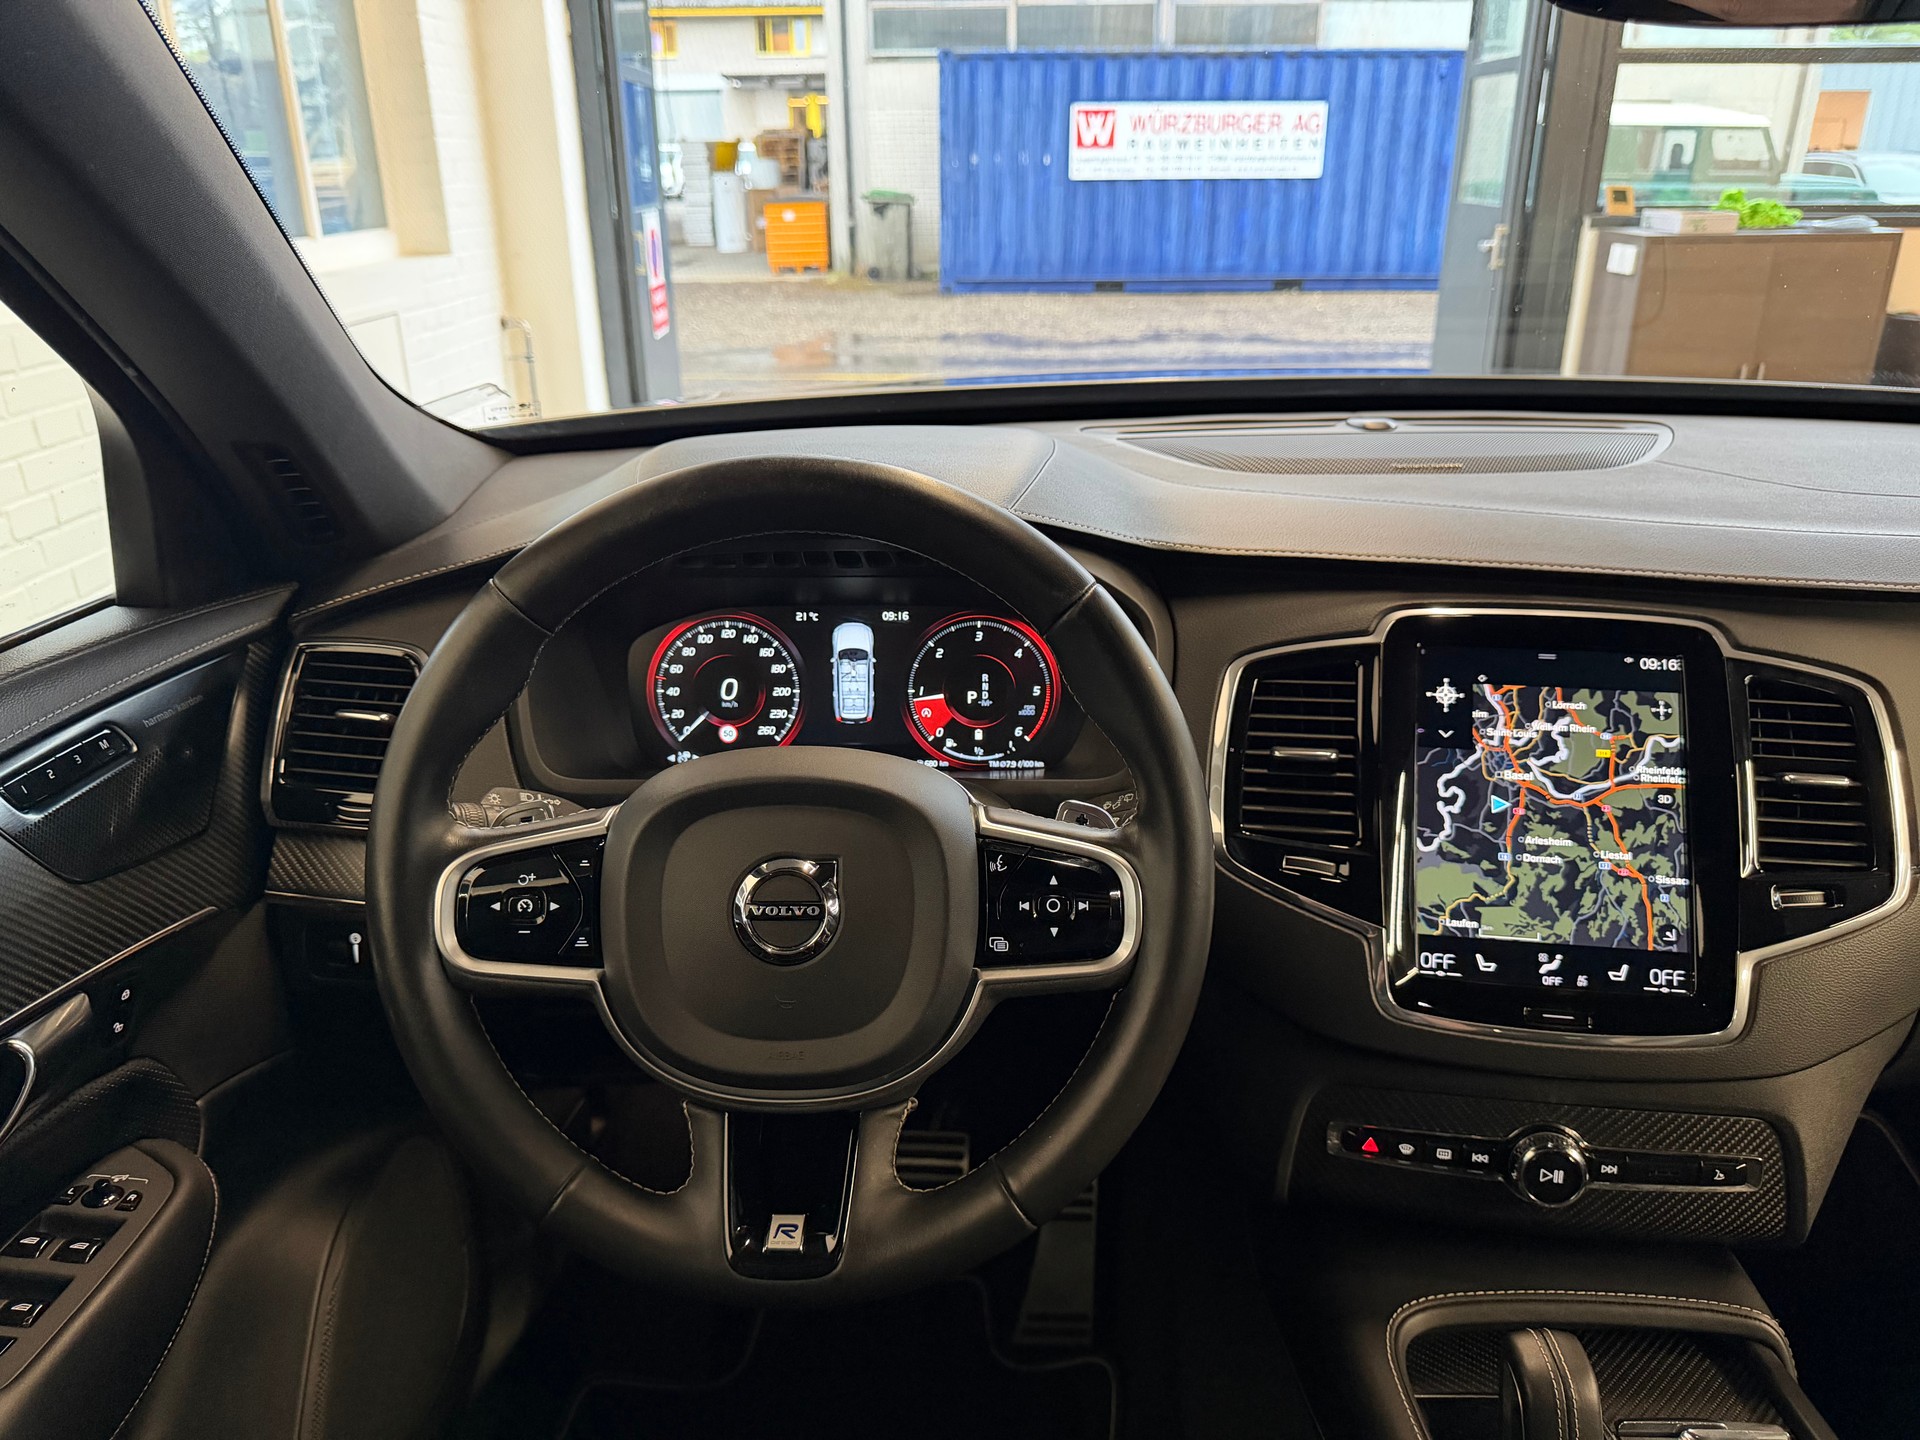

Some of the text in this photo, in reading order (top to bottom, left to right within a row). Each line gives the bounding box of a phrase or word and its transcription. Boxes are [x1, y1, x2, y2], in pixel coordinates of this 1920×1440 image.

[1129, 106, 1321, 134] WÜRZBURGER AG
[1077, 109, 1116, 149] W
[795, 611, 807, 621] 21
[882, 611, 910, 621] 09:16
[697, 634, 714, 644] 100
[720, 629, 737, 639] 120
[742, 634, 759, 644] 140
[974, 631, 984, 642] 3
[681, 647, 696, 657] 80
[758, 647, 775, 657] 160
[935, 648, 944, 658] 2
[1014, 648, 1023, 658] 4
[669, 664, 684, 674] 60
[770, 664, 787, 674] 180
[1639, 657, 1677, 671] 09:16
[982, 673, 989, 682] R
[720, 678, 739, 701] 0
[772, 686, 792, 697] 200
[982, 682, 989, 691] N
[1032, 686, 1042, 696] 5
[666, 687, 681, 697] 40
[967, 690, 978, 704] P
[982, 691, 989, 700] D
[721, 700, 739, 709] km/h
[1552, 700, 1588, 710] Lörrach
[670, 709, 685, 719] 20
[769, 709, 788, 719] 230
[723, 729, 734, 738] 50
[757, 725, 776, 736] 260
[936, 728, 944, 738] 0
[1014, 726, 1024, 737] 6
[1570, 724, 1597, 733] Rhein
[100, 738, 110, 750] M
[73, 754, 82, 764] 3
[46, 769, 56, 780] 2
[1504, 770, 1534, 781] Basel
[1657, 794, 1674, 804] 3D
[1525, 836, 1574, 846] Arlesheim
[1600, 851, 1633, 860] Liestal
[749, 905, 821, 916] VOLVO
[1446, 918, 1479, 929] Laufen
[1420, 952, 1456, 970] OFF
[1542, 976, 1564, 986] OFF
[1650, 968, 1687, 986] OFF
[772, 1224, 799, 1239] R
